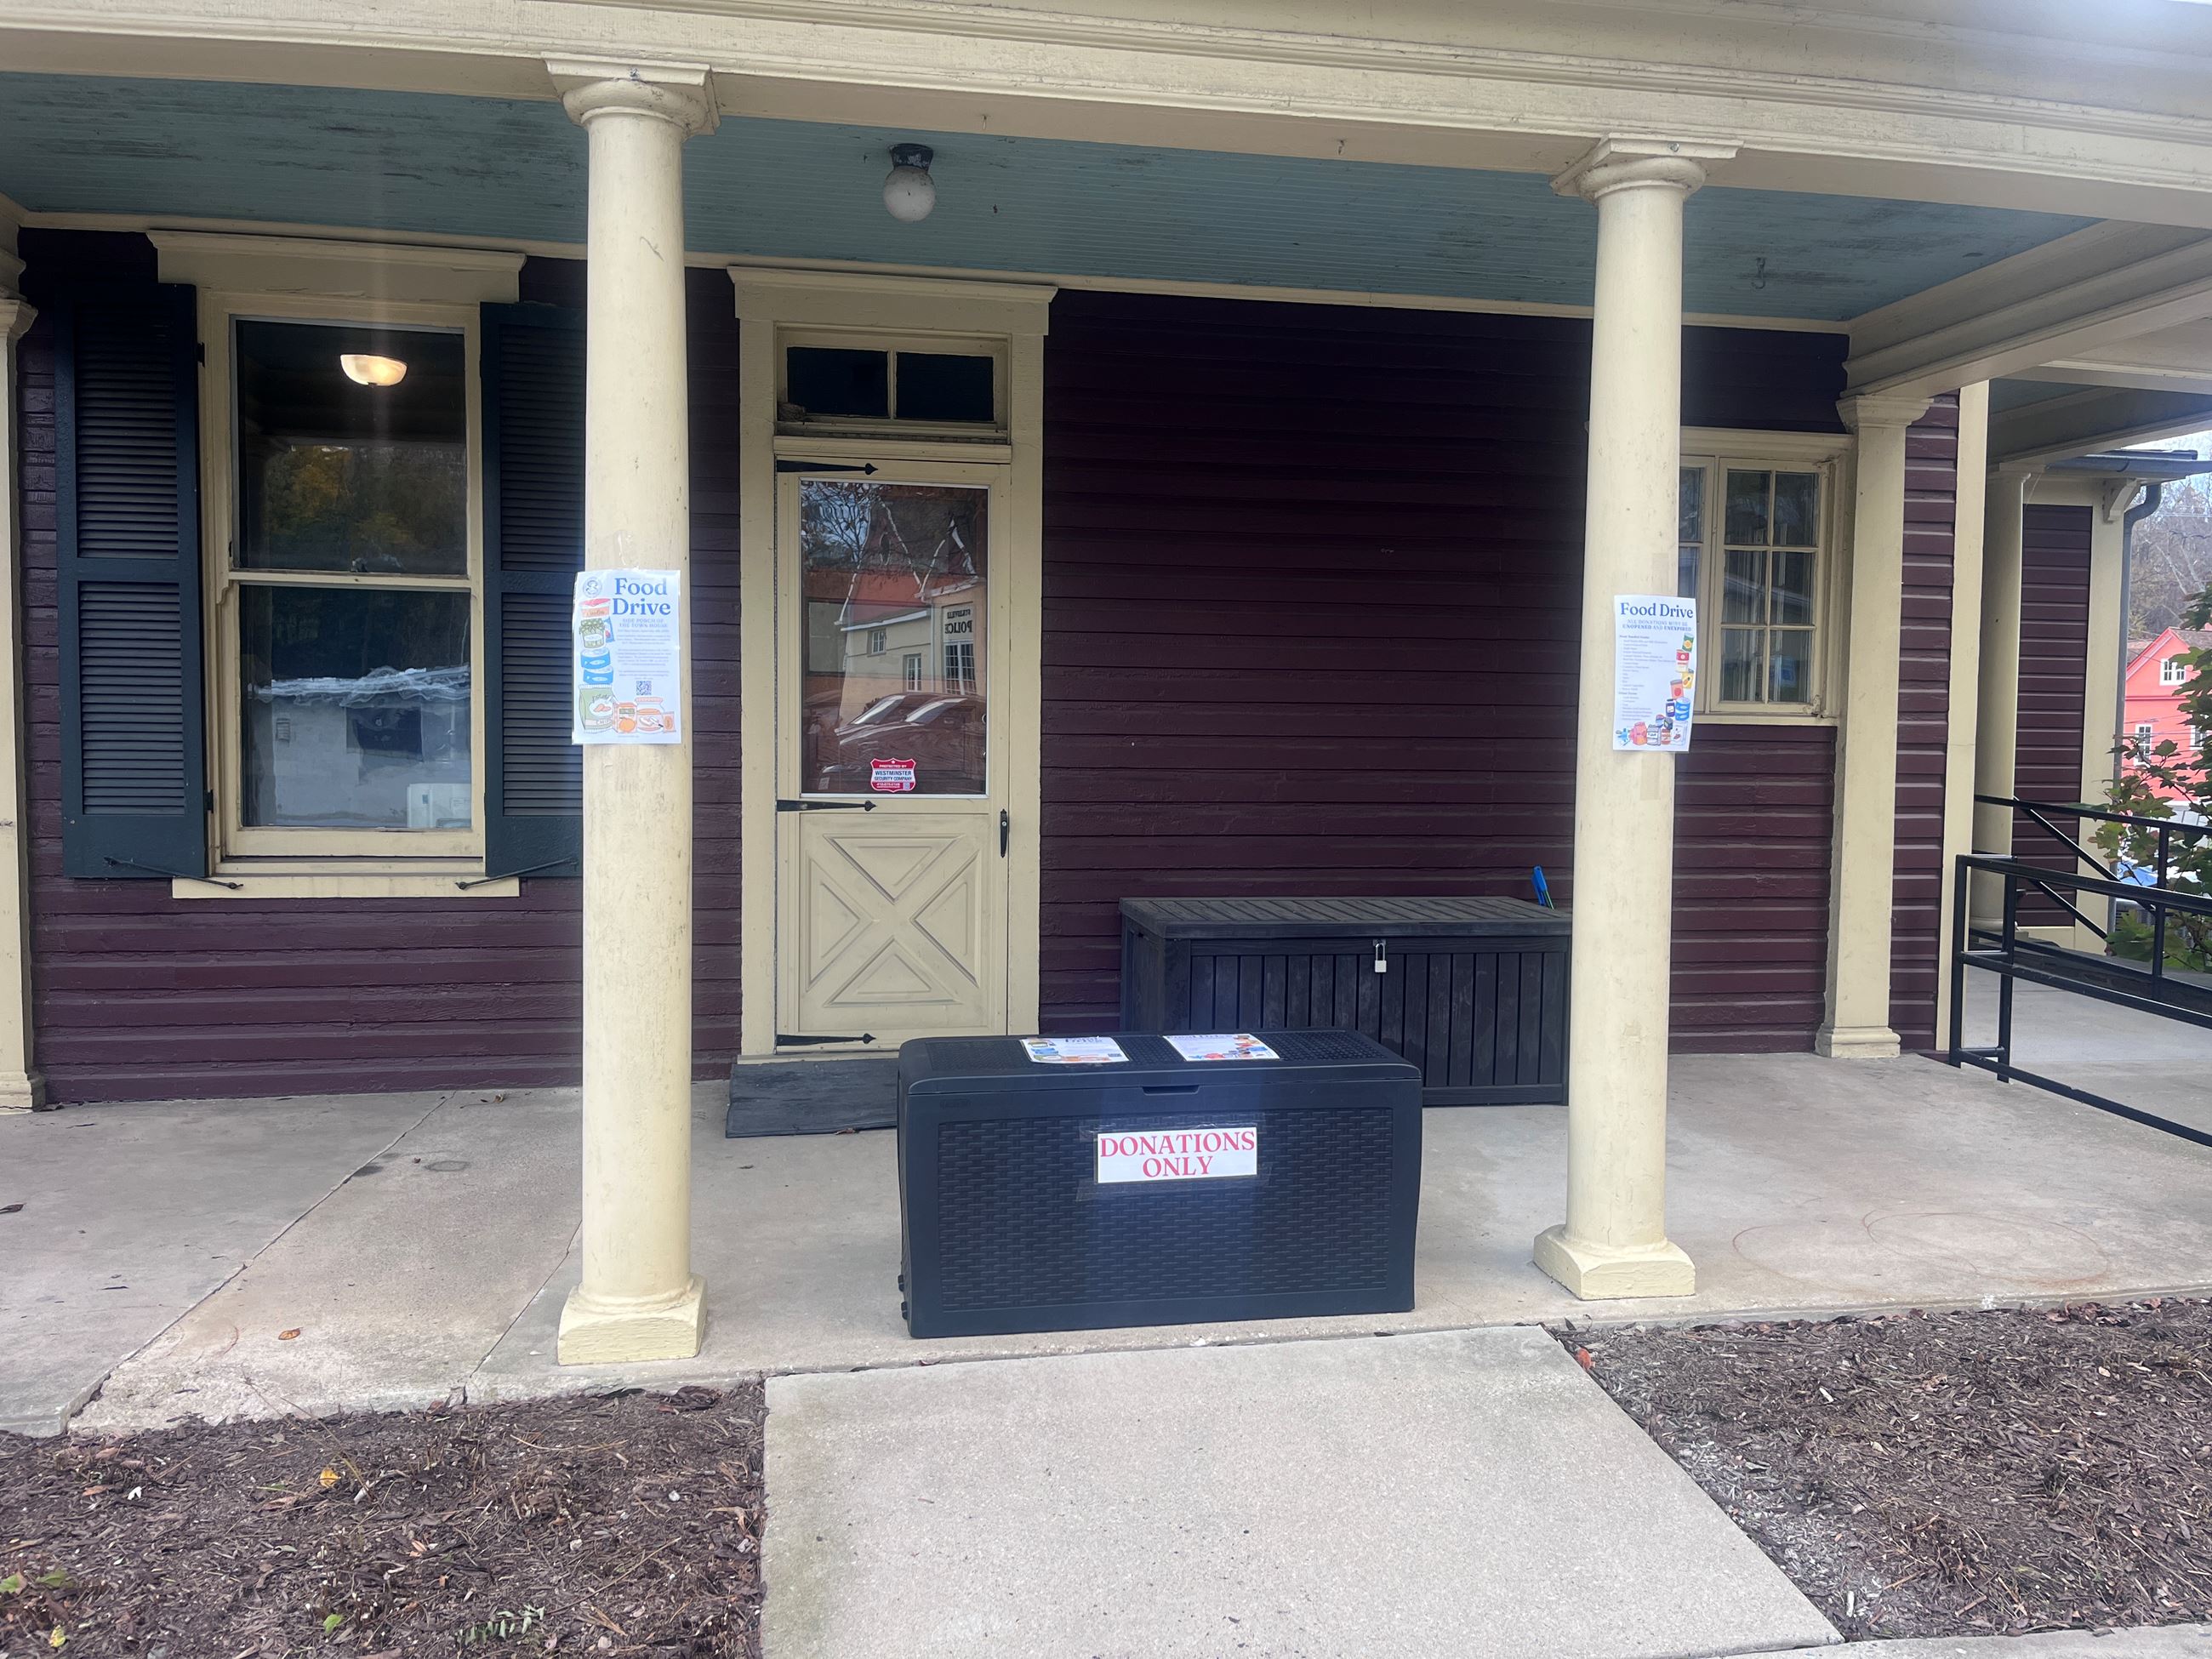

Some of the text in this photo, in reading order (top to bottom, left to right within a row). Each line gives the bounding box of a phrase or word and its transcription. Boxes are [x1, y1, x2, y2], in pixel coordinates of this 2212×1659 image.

[614, 578, 668, 596] Food
[612, 597, 671, 616] Drive
[1620, 601, 1694, 619] Food Drive
[1100, 1131, 1255, 1157] DONATIONS
[1143, 1155, 1213, 1177] ONLY
